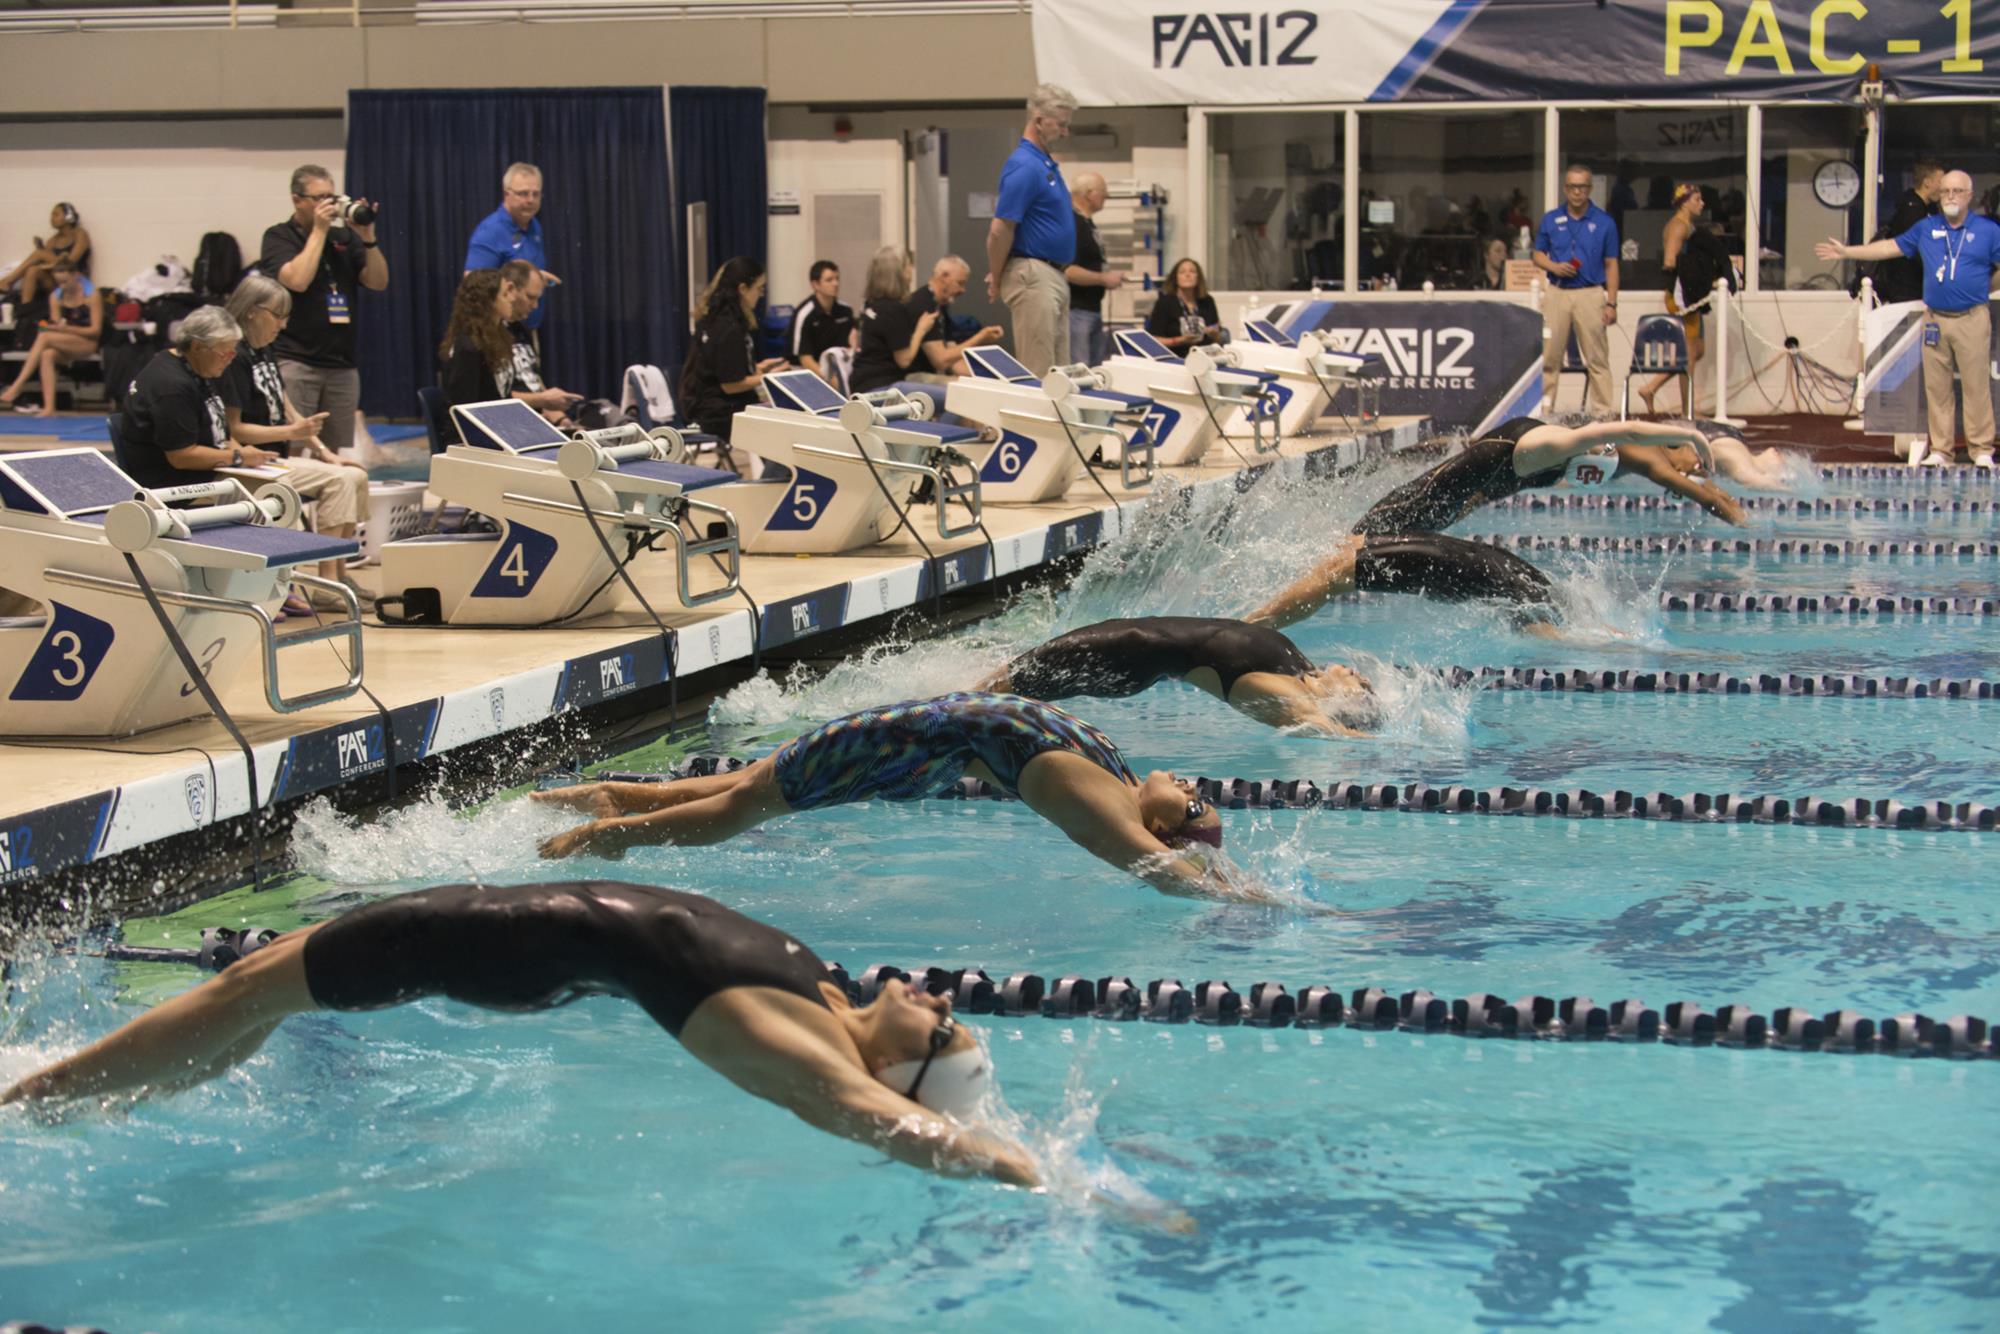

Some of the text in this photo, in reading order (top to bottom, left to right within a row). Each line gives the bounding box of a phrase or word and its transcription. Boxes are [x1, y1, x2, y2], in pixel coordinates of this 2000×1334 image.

[1152, 10, 1319, 69] PAC12
[1664, 0, 1984, 76] PAC-1
[1343, 377, 1476, 389] NFERENCE
[1147, 413, 1167, 441] 7
[999, 442, 1021, 475] 6
[793, 485, 818, 522] 5
[500, 543, 529, 587] 4
[51, 630, 86, 687] 3
[340, 758, 386, 778] CONFERENCE
